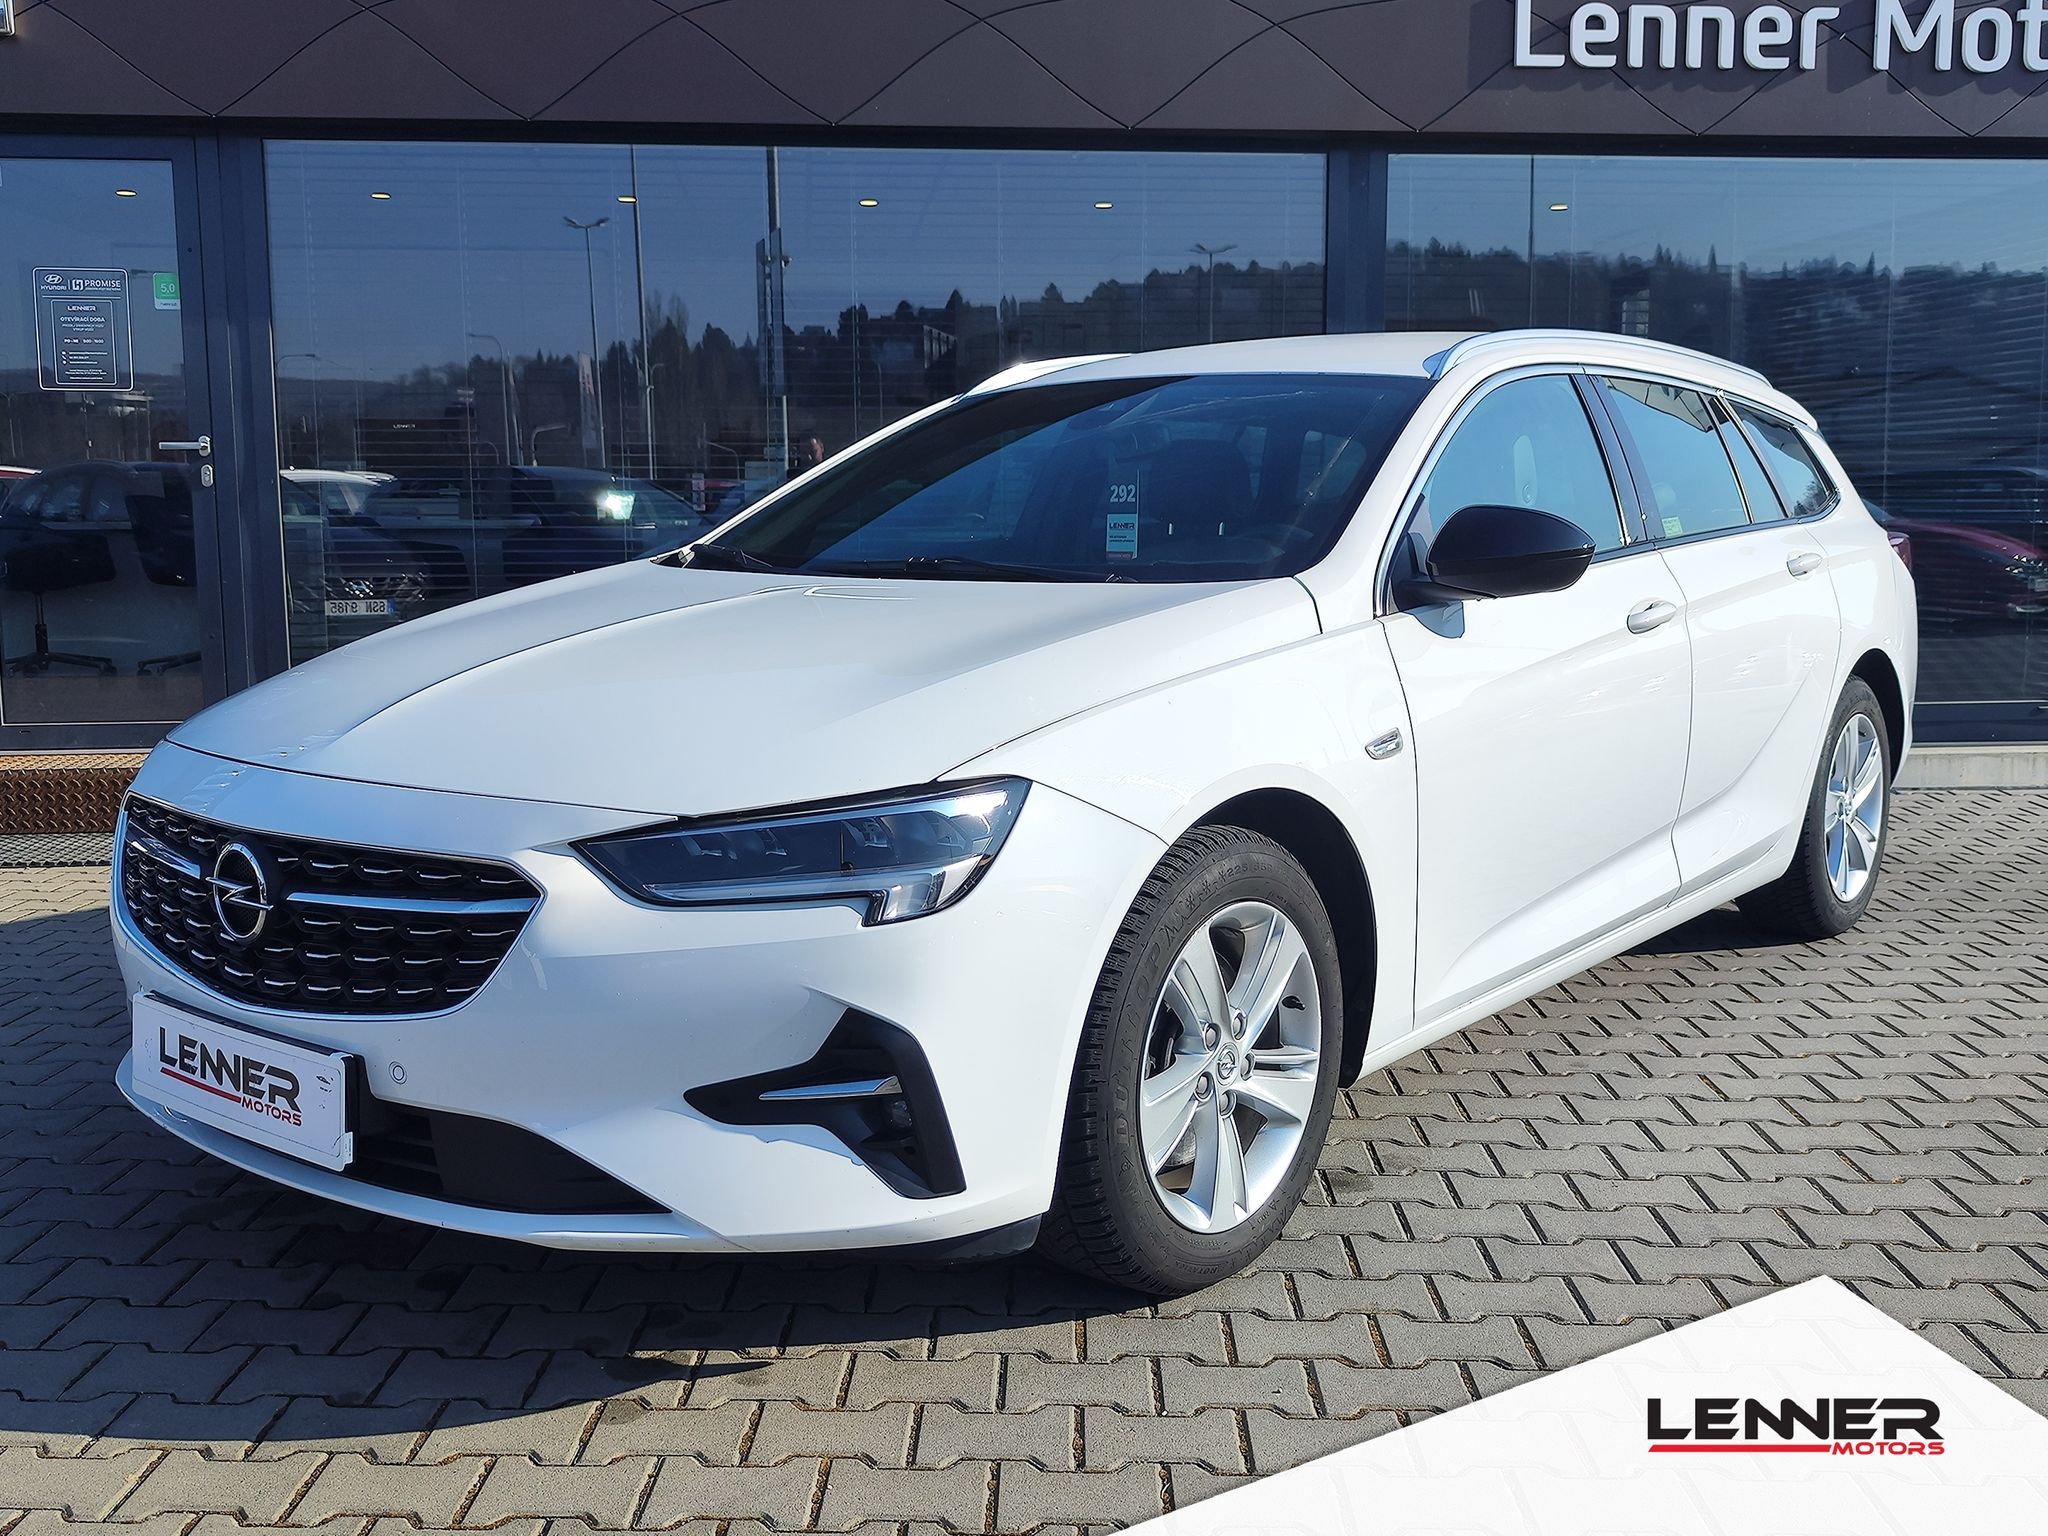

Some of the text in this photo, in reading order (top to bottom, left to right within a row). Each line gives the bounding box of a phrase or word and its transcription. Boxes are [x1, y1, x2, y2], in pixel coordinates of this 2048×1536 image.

[1514, 0, 2048, 74] Lenner Mot
[85, 279, 121, 288] PROMISE
[1110, 484, 1136, 503] 292
[160, 1026, 302, 1113] LENNER
[241, 1097, 302, 1127] MOTORS
